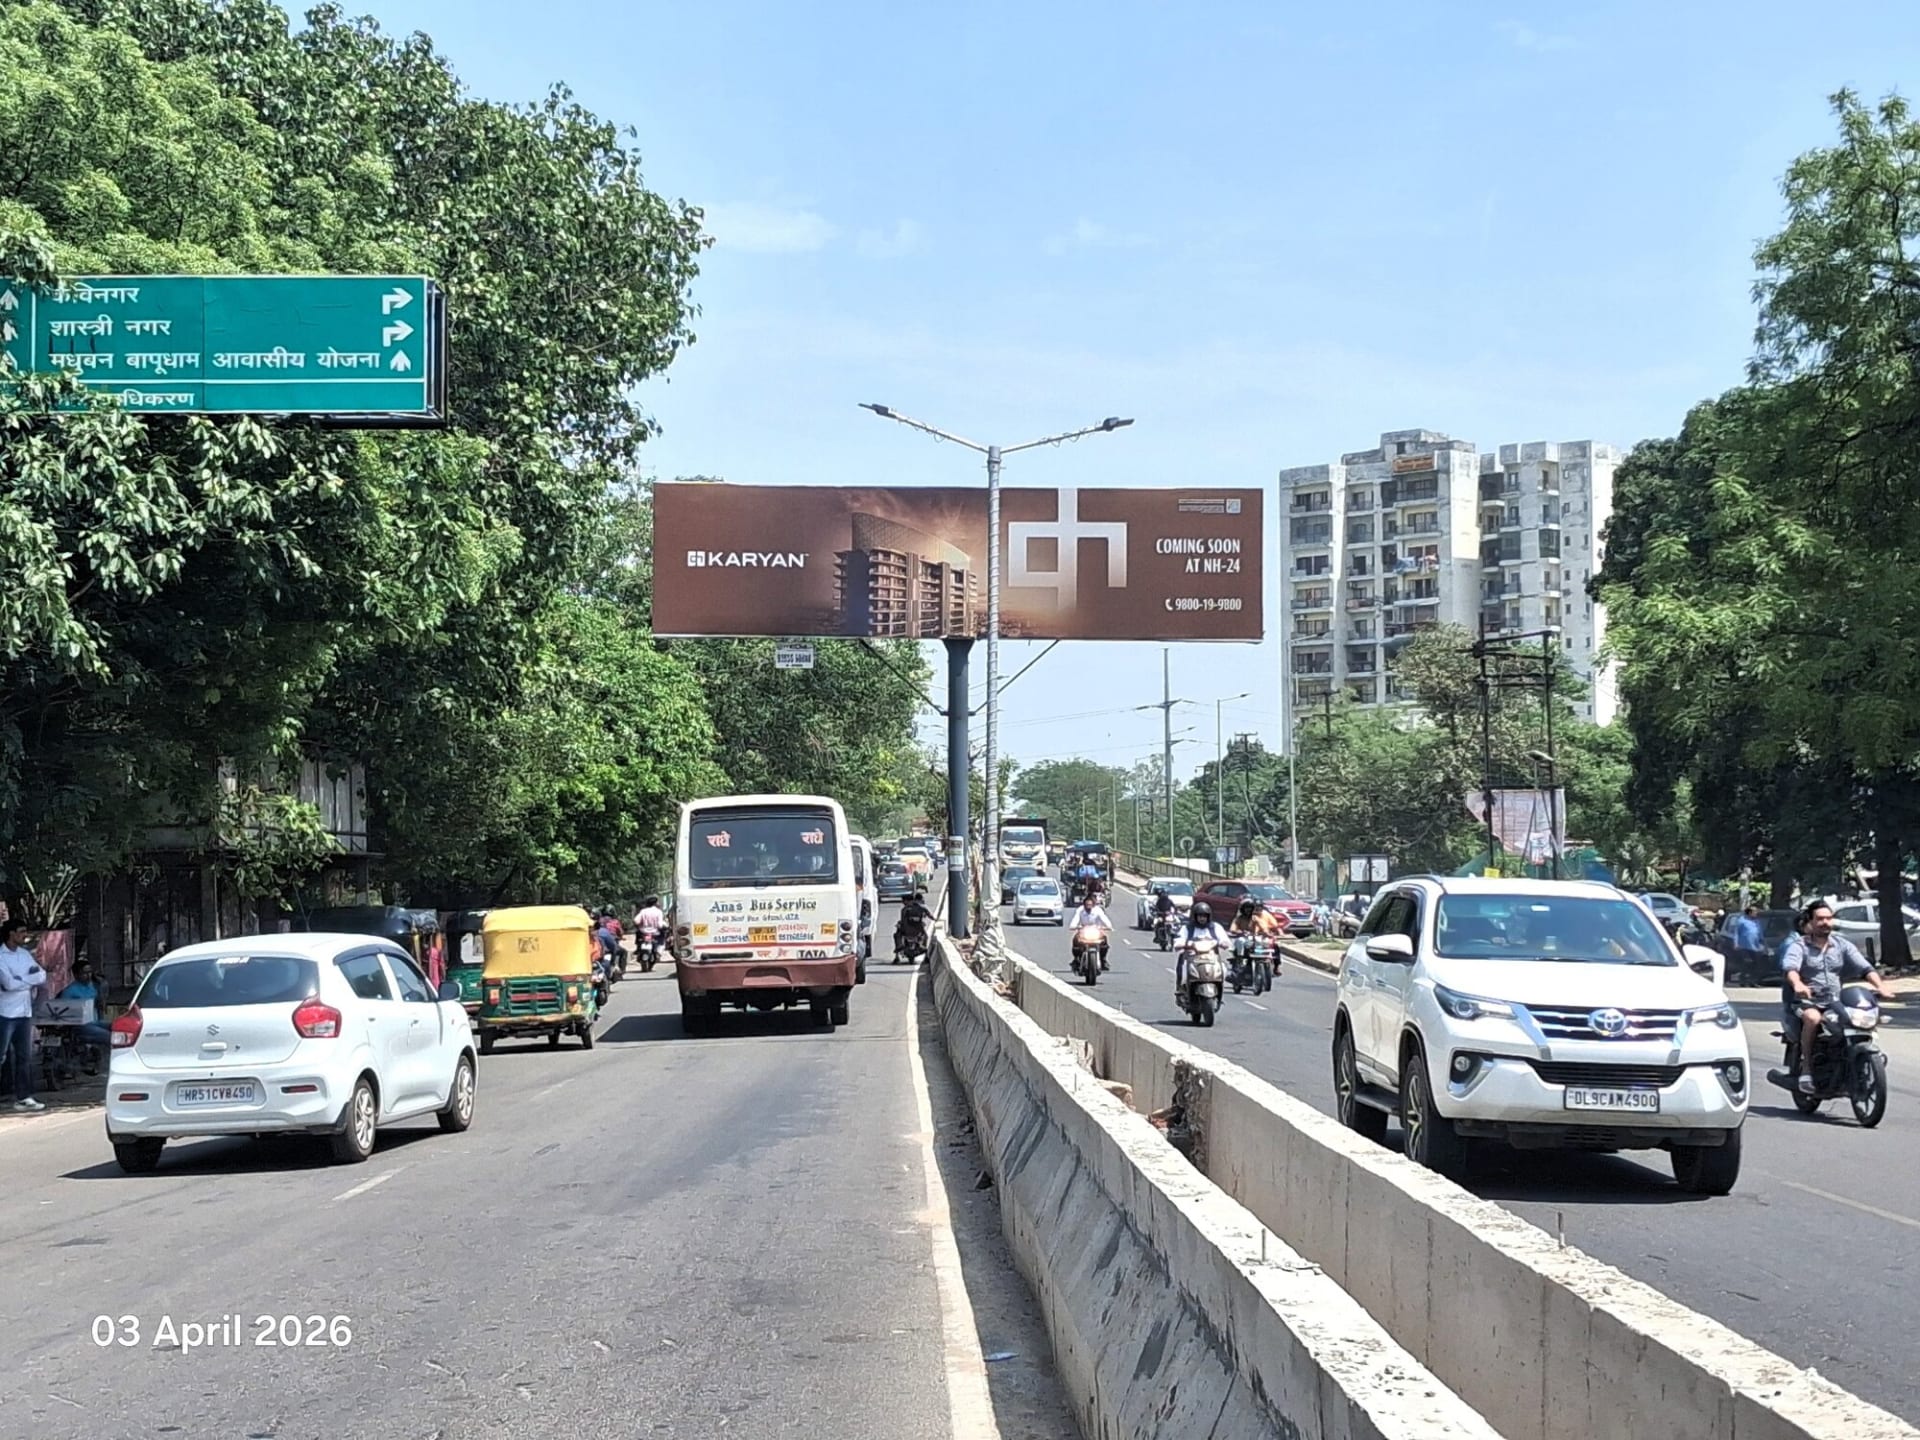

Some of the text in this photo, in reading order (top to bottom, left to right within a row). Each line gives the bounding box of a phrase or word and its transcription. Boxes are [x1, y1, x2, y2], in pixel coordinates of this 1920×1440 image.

[49, 314, 172, 336] शास्त्री नगर
[125, 352, 200, 375] बापूधाम
[212, 346, 305, 369] आवासीय
[317, 346, 381, 369] योजना
[1156, 538, 1241, 554] COMING SOON
[708, 551, 805, 568] KARYAN
[1185, 558, 1241, 573] AT NH-24
[1175, 598, 1242, 612] 9800-19-9800
[707, 830, 731, 848] राधे
[800, 828, 824, 845] राधे
[709, 897, 817, 913] Anas Bus Service
[798, 949, 827, 959] TATA
[1575, 1090, 1657, 1108] DL9CAM4900
